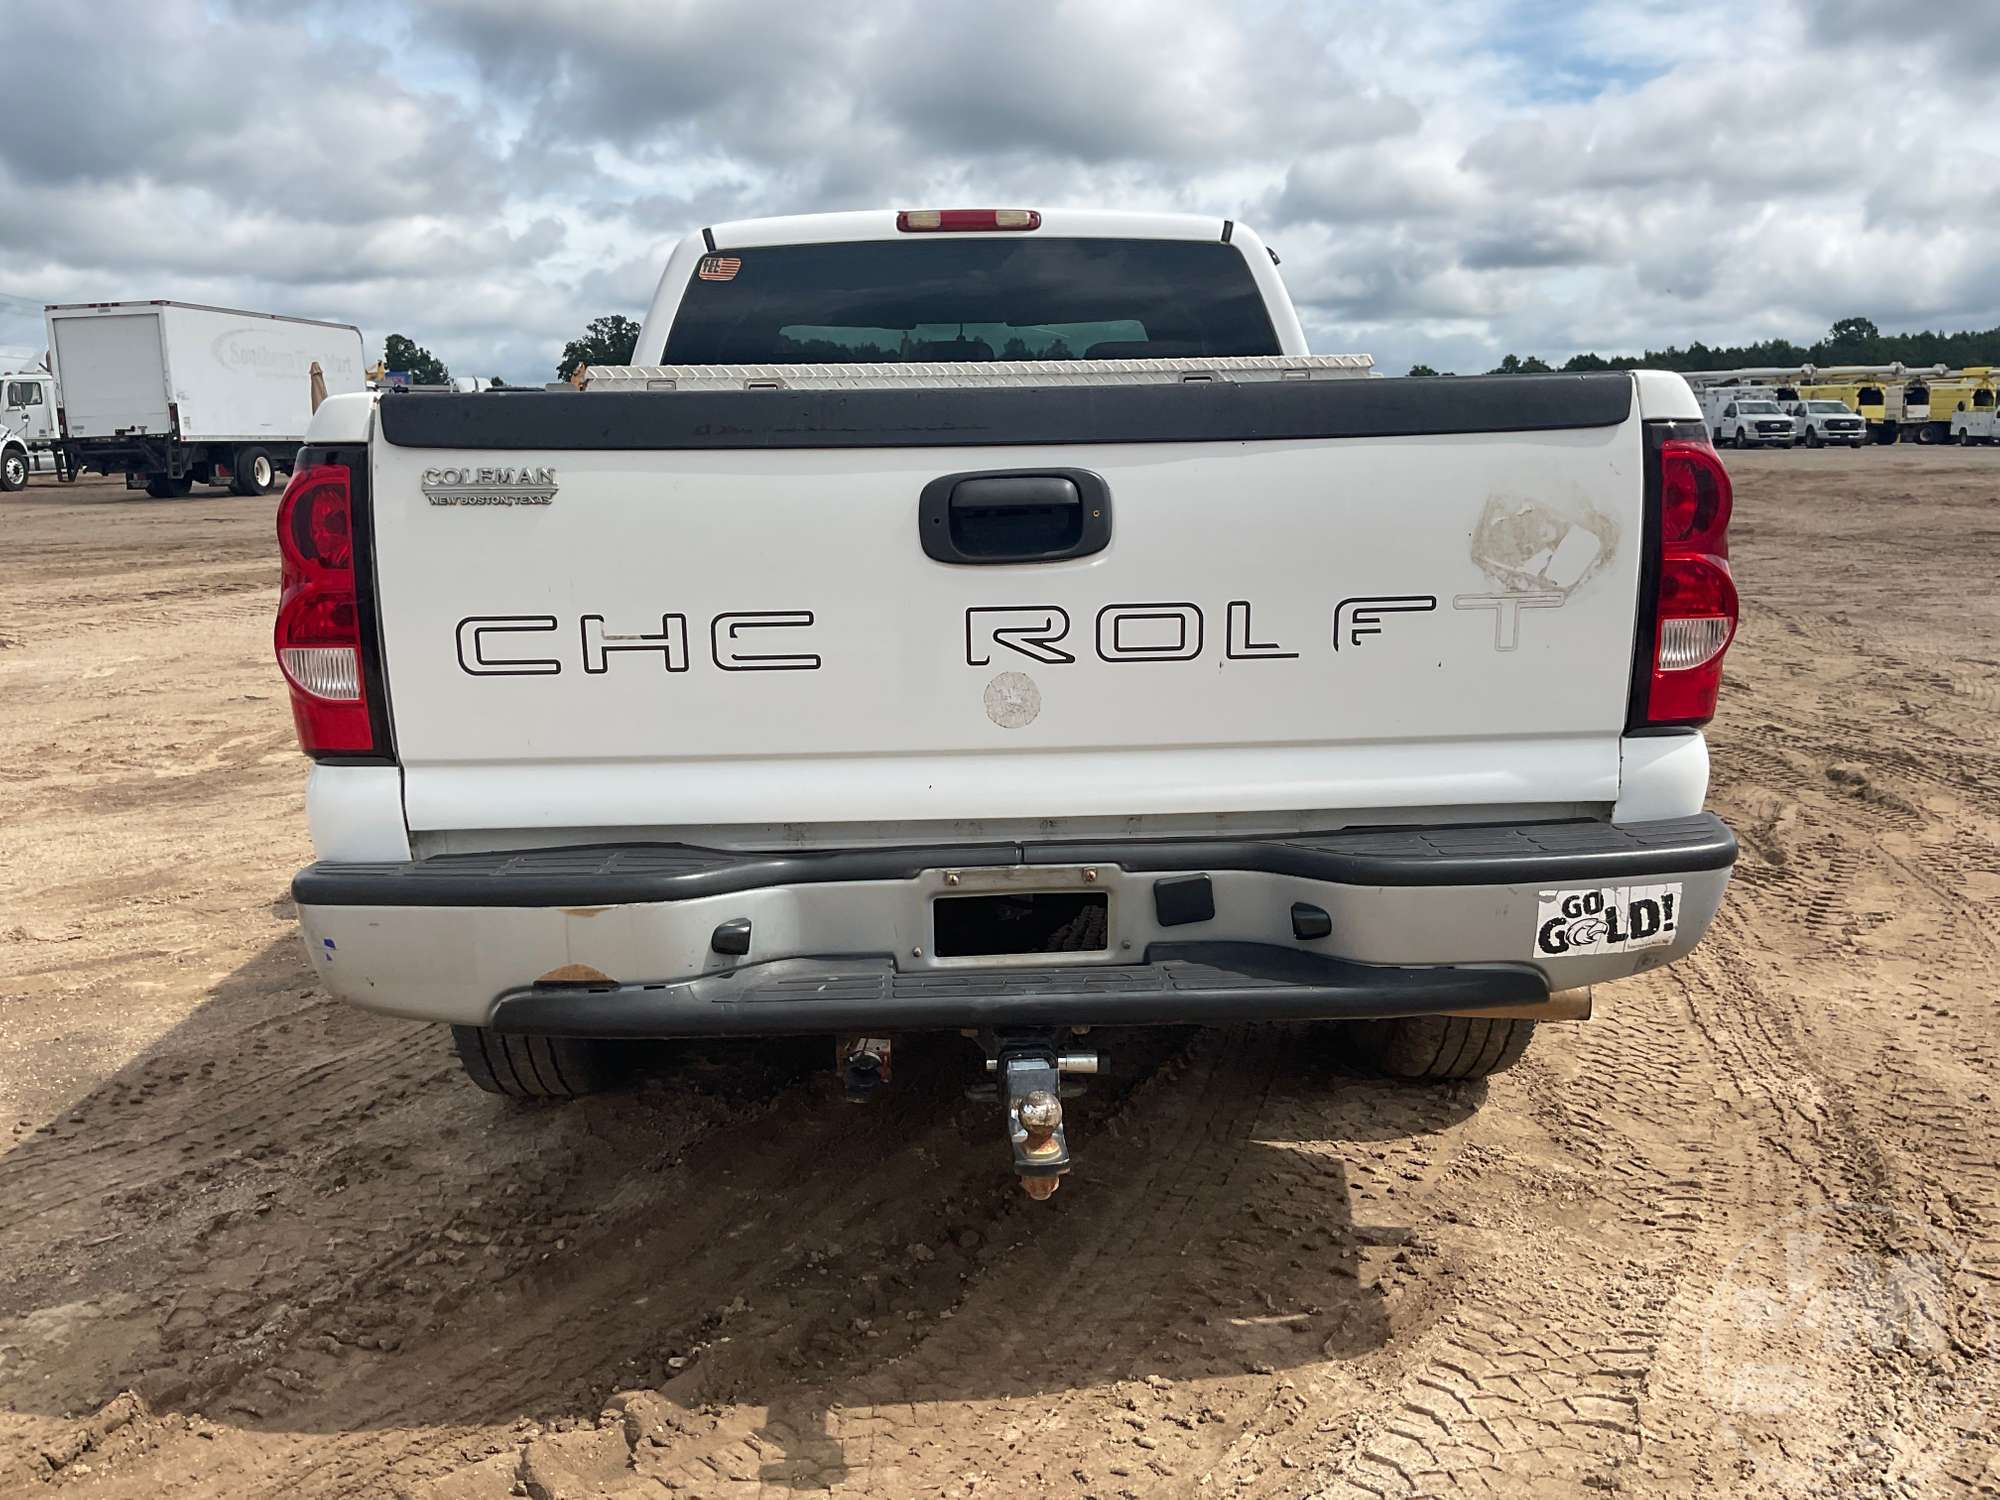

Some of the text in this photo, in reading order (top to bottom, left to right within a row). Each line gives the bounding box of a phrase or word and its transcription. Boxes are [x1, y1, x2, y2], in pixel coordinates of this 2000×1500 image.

[424, 467, 558, 486] COLEMAN
[428, 496, 458, 506] NEW
[514, 495, 553, 505] TEXAS
[1562, 891, 1605, 919] GO
